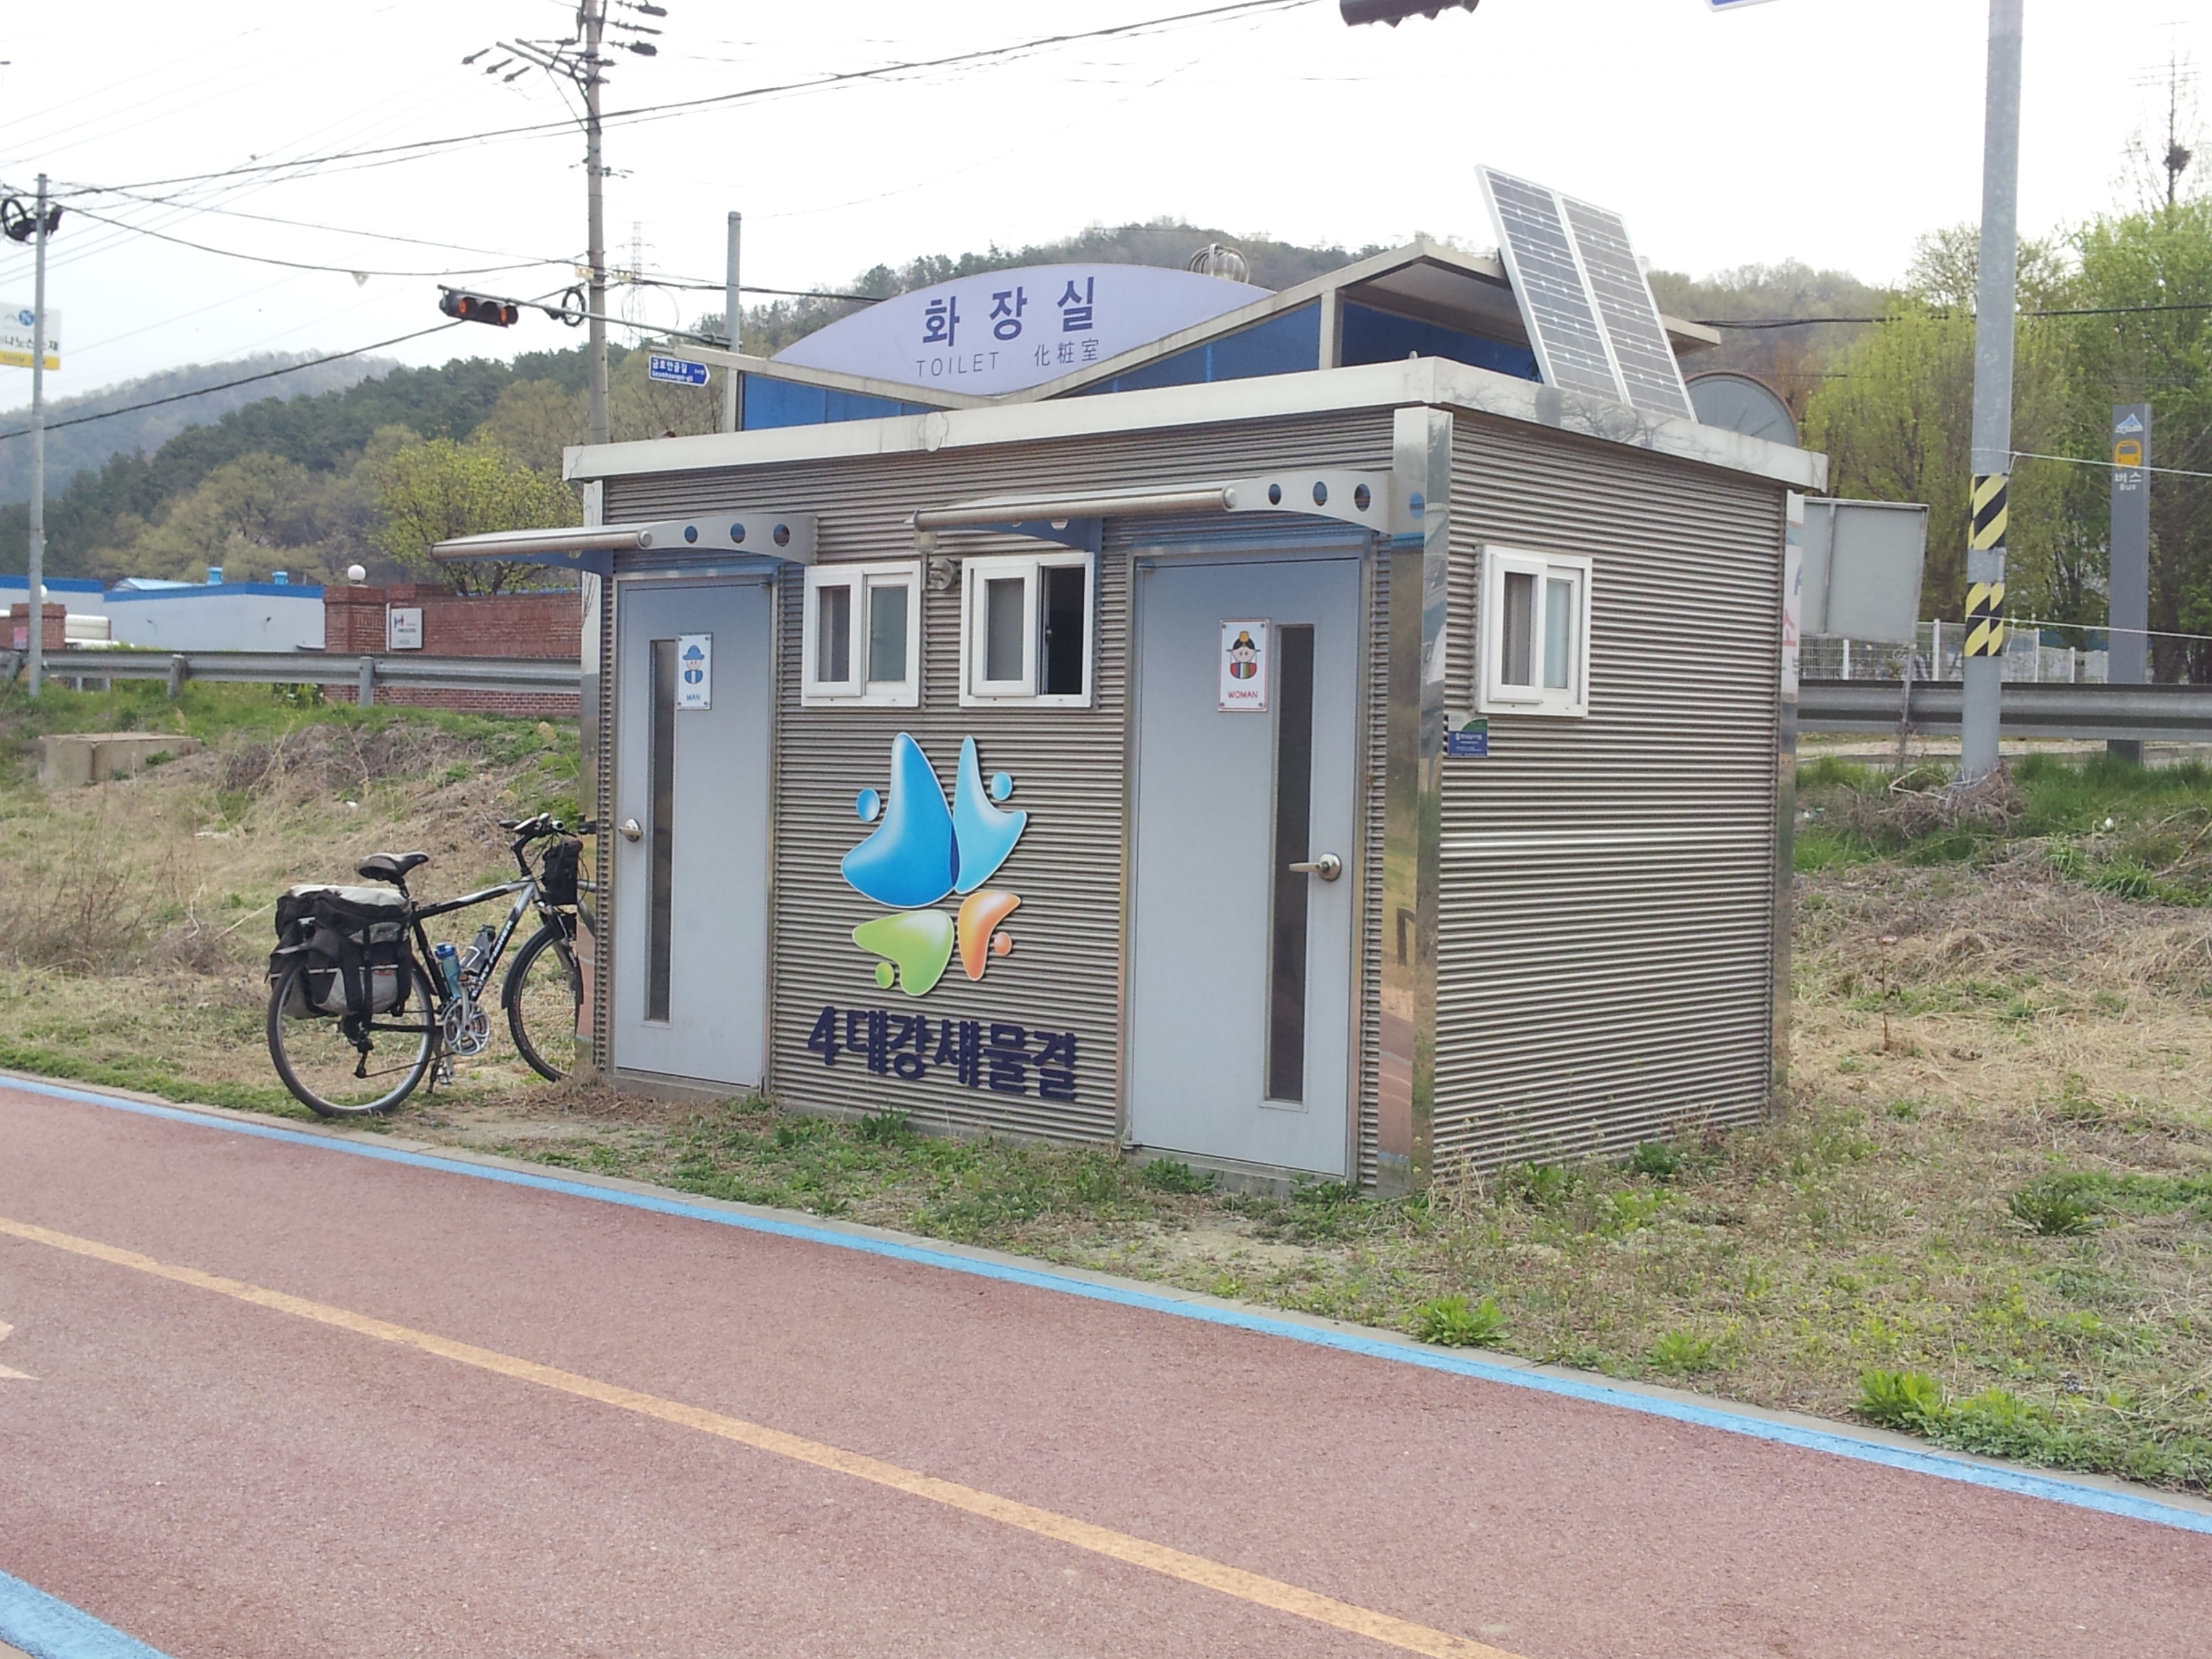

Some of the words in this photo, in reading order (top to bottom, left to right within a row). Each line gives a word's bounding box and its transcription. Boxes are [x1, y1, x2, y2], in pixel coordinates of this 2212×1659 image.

[922, 276, 1095, 348] 화장실
[916, 351, 1000, 377] TOILET
[1033, 338, 1099, 367] 化粧室
[2114, 472, 2142, 483] 버스
[1227, 691, 1258, 699] WOMAN
